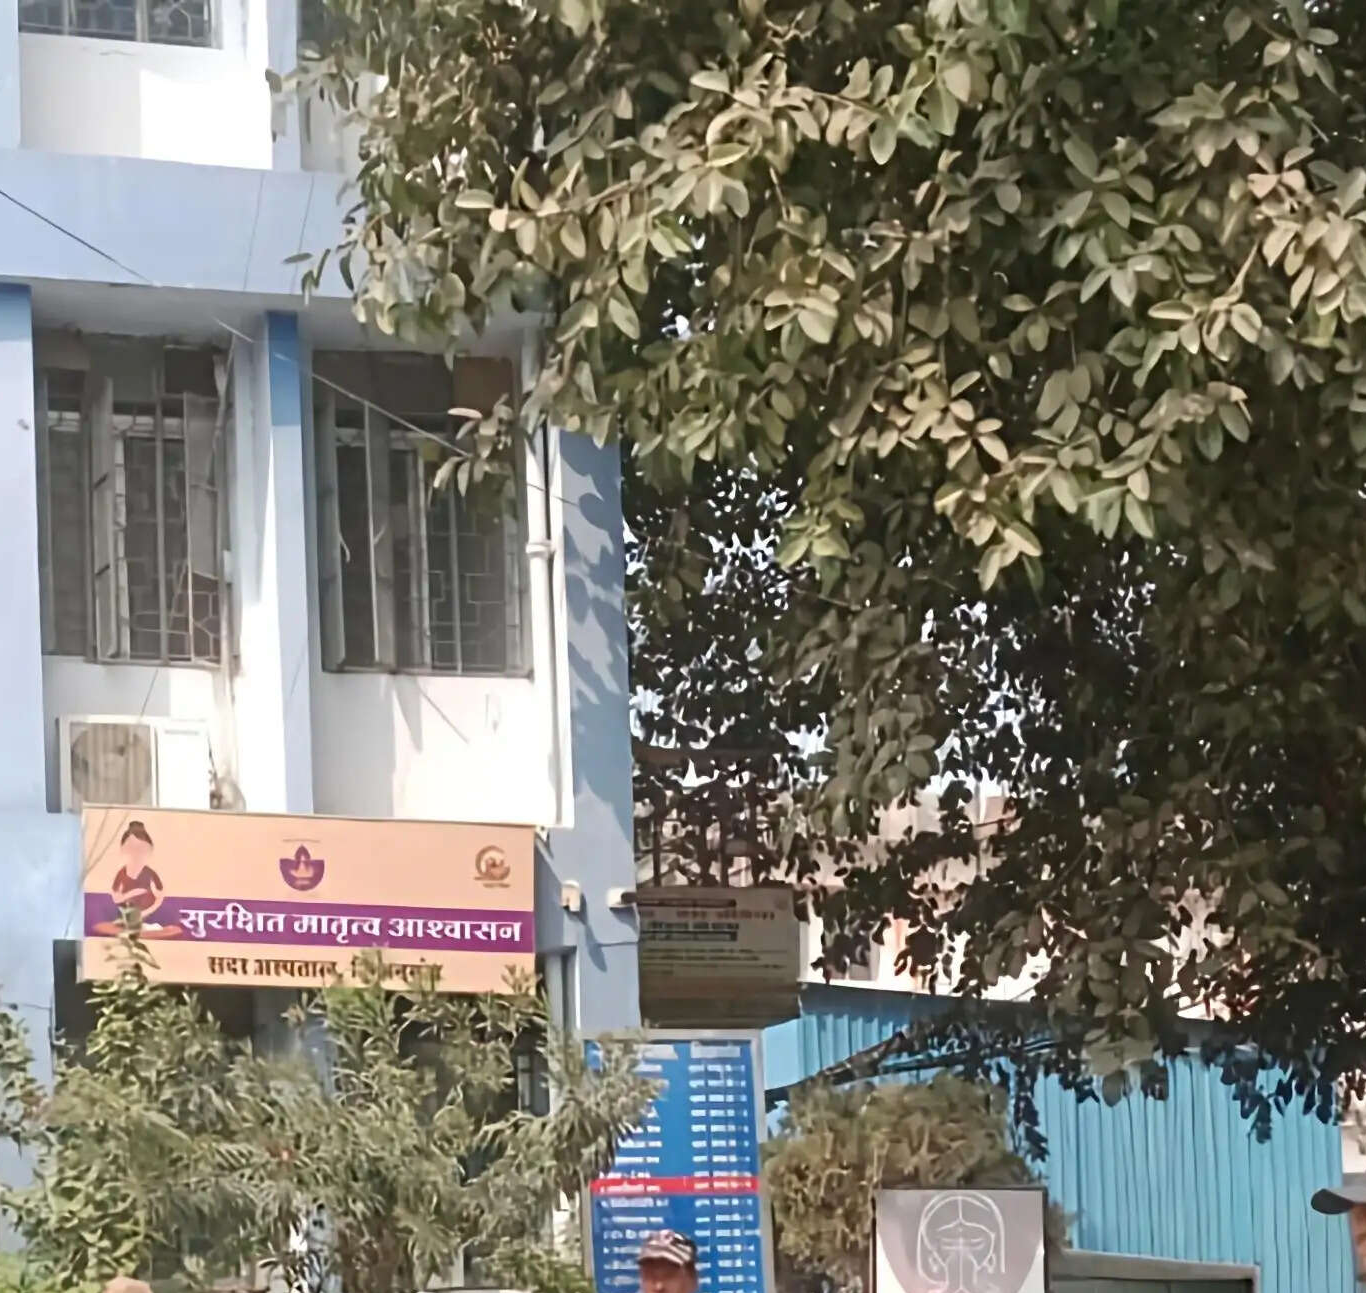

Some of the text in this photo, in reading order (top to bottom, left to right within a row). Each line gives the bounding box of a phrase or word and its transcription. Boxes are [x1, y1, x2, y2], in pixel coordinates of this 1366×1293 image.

[179, 903, 523, 944] सुरक्षित मातृत्व आश्वासन
